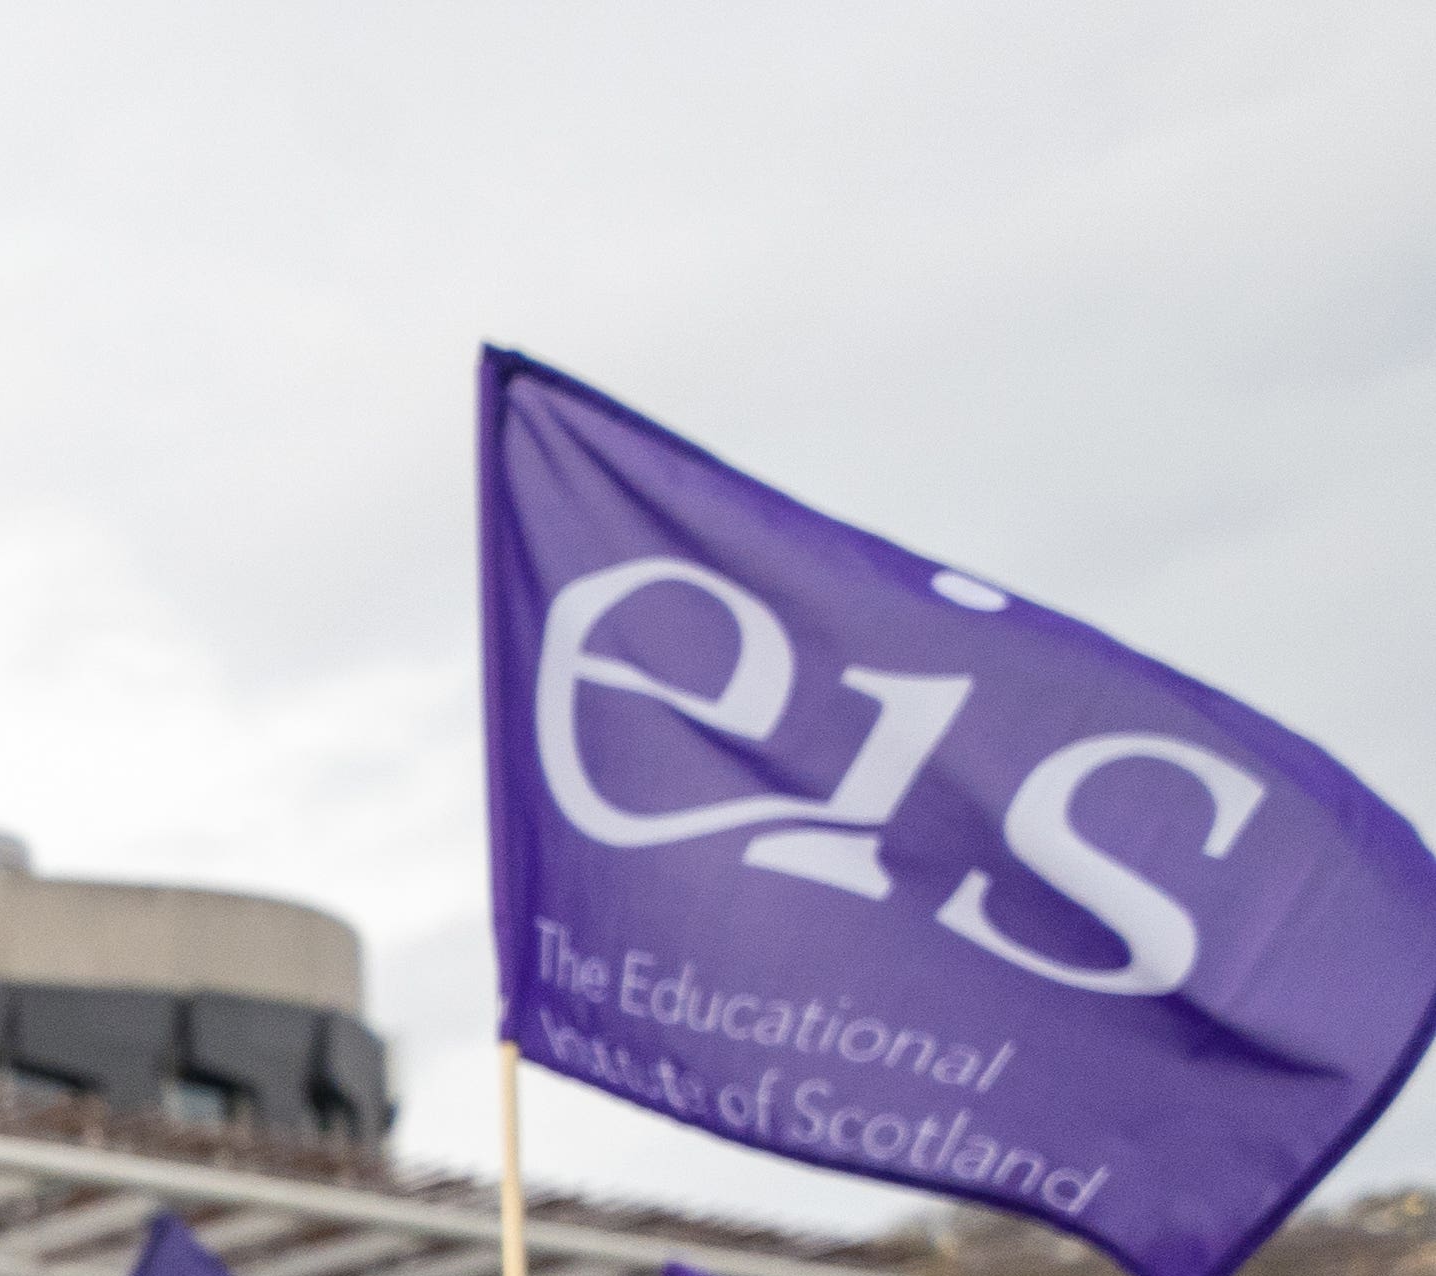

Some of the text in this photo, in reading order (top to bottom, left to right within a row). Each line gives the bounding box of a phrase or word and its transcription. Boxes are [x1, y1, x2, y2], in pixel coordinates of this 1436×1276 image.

[535, 556, 1269, 998] eis
[534, 914, 1018, 1096] The Educational
[716, 1066, 780, 1140] of
[792, 1076, 1112, 1216] Scotland
